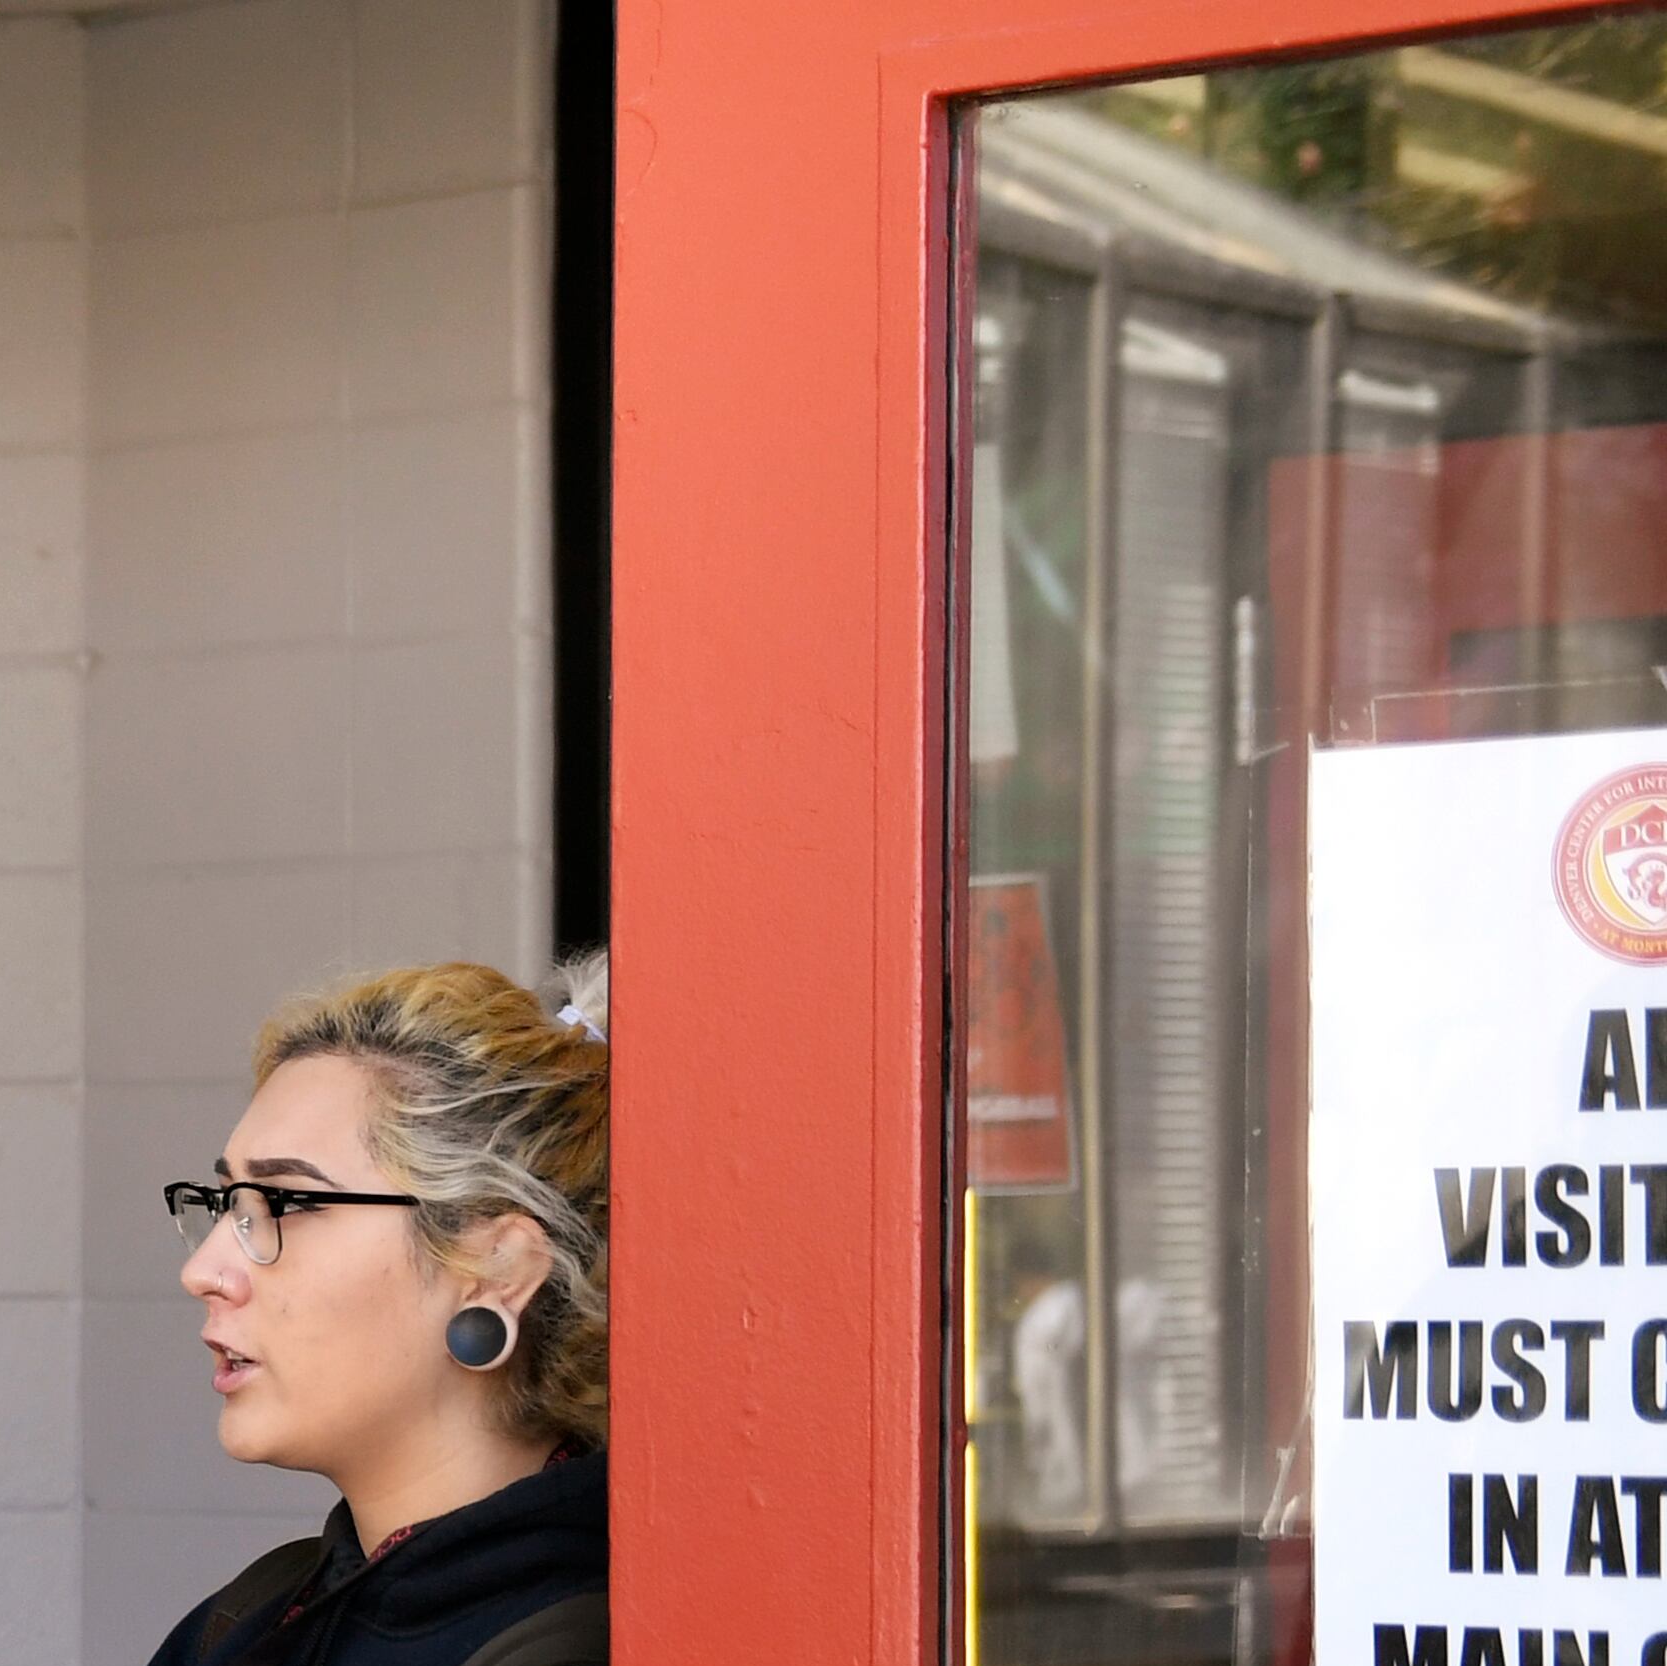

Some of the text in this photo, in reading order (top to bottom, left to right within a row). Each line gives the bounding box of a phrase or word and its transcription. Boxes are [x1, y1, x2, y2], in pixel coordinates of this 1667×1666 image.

[1567, 802, 1605, 858] CENTER
[1603, 782, 1634, 806] FOR
[1565, 861, 1595, 925] DENVER
[1435, 1163, 1667, 1268] VISIT
[1343, 1318, 1606, 1423] MUST
[1448, 1473, 1667, 1578] IN AT
